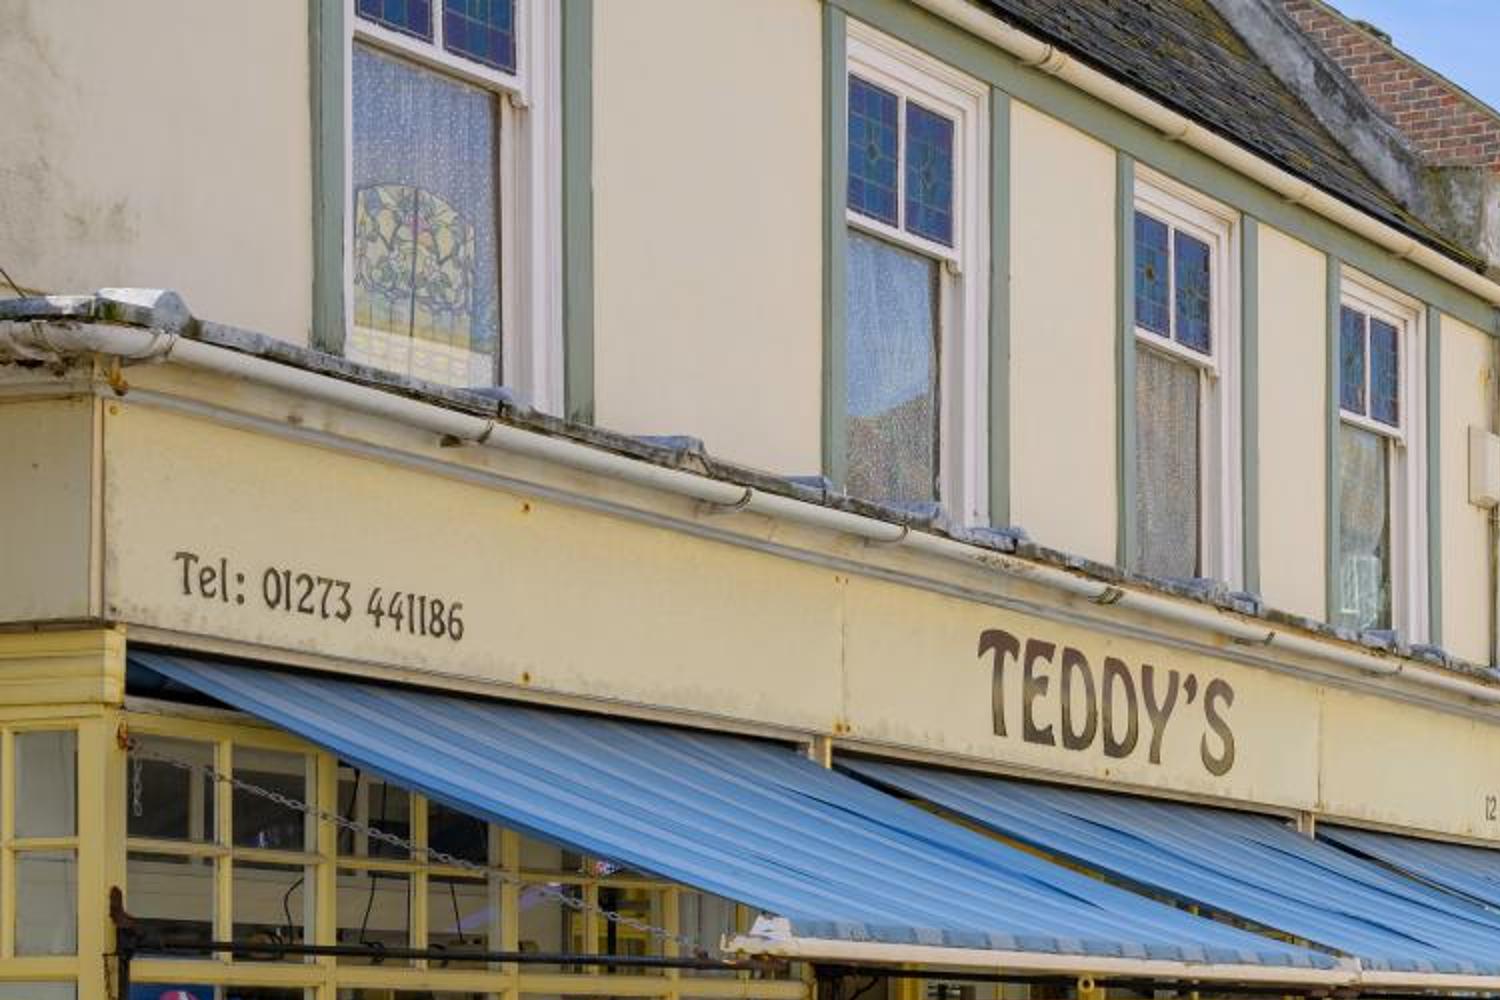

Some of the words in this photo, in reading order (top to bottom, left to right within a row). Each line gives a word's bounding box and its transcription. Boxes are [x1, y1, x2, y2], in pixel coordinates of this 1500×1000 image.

[175, 551, 246, 606] Tel:
[262, 566, 352, 622] 01273
[367, 586, 466, 641] 441186
[977, 628, 1236, 777] TEDDY'S
[1485, 795, 1497, 821] 12
